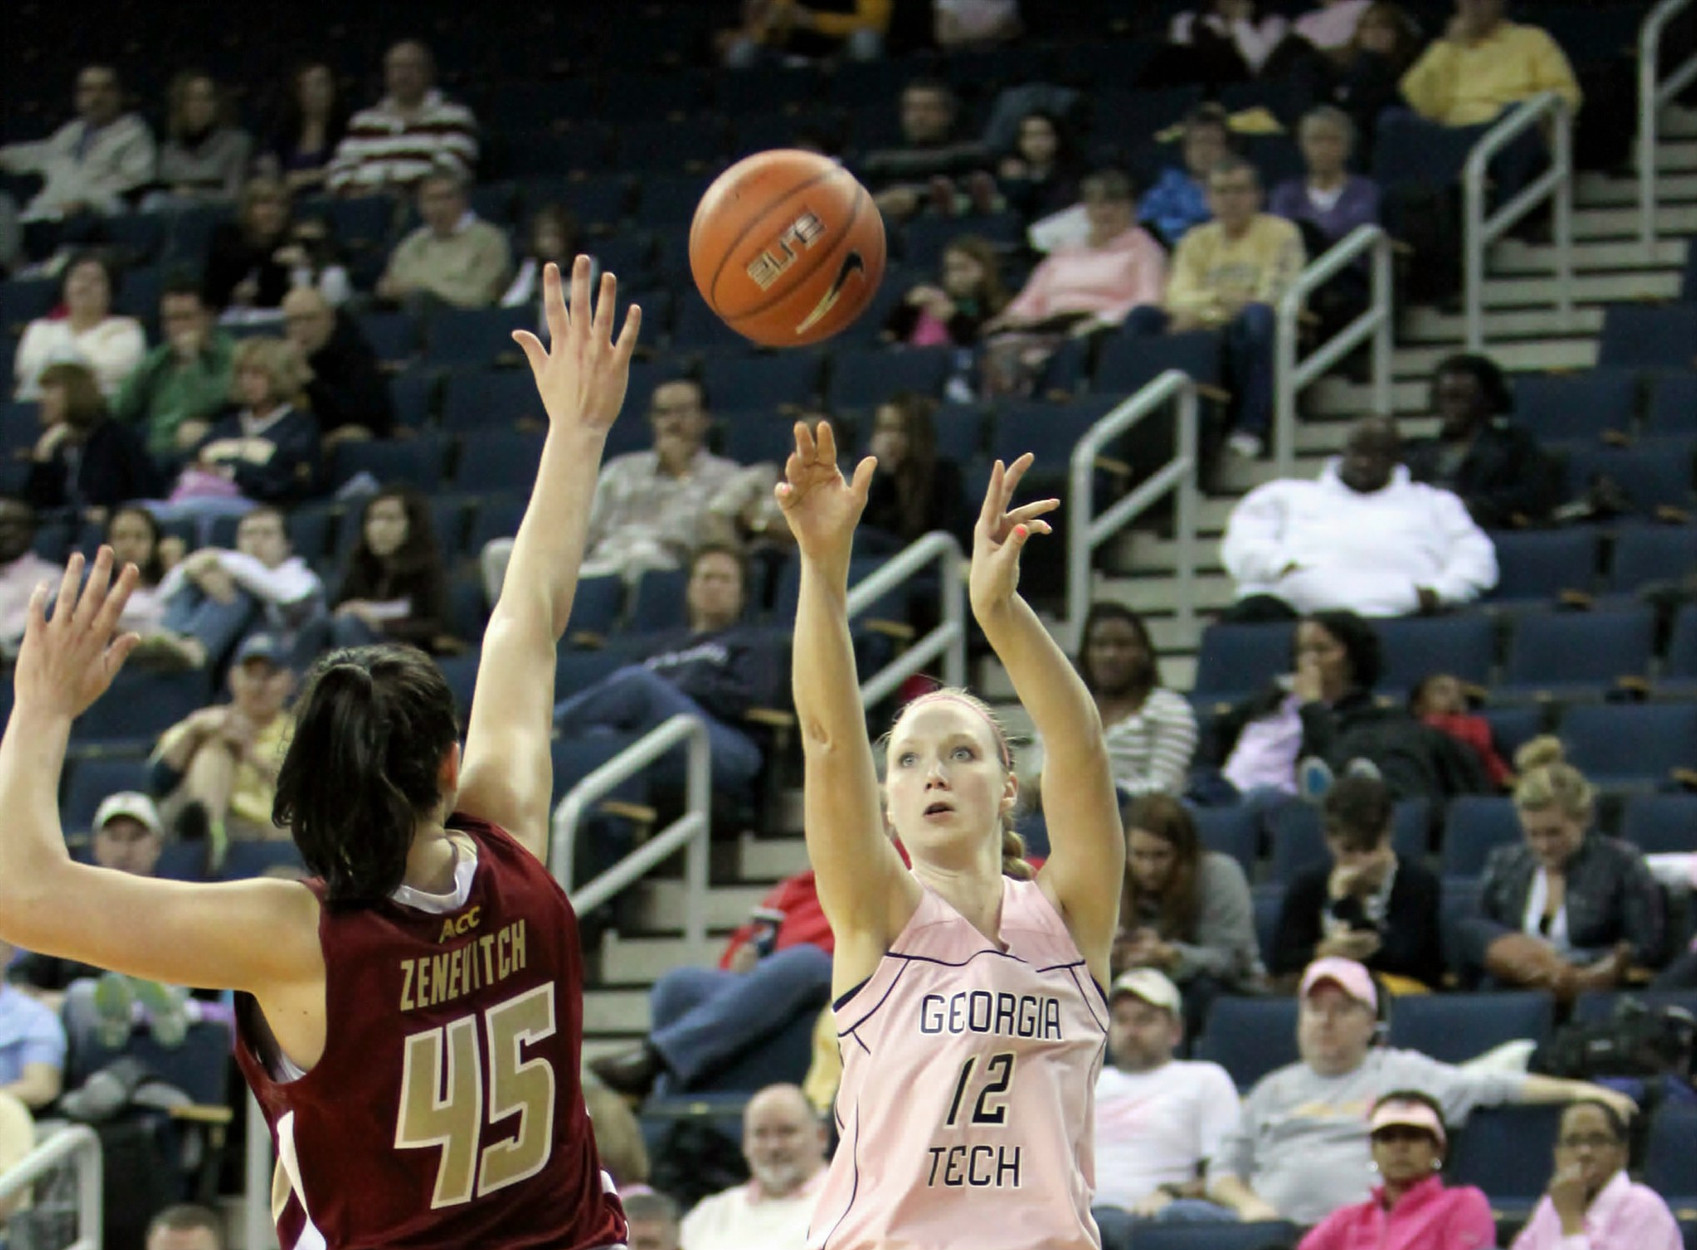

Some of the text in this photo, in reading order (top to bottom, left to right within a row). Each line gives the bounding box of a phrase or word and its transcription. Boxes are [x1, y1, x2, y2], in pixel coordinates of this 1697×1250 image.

[439, 905, 480, 944] ACC
[400, 918, 526, 1012] ZENEVITCH
[919, 989, 1063, 1041] GEORGIA
[394, 981, 556, 1210] 45
[945, 1052, 1015, 1126] 12
[927, 1145, 1021, 1188] TECH
